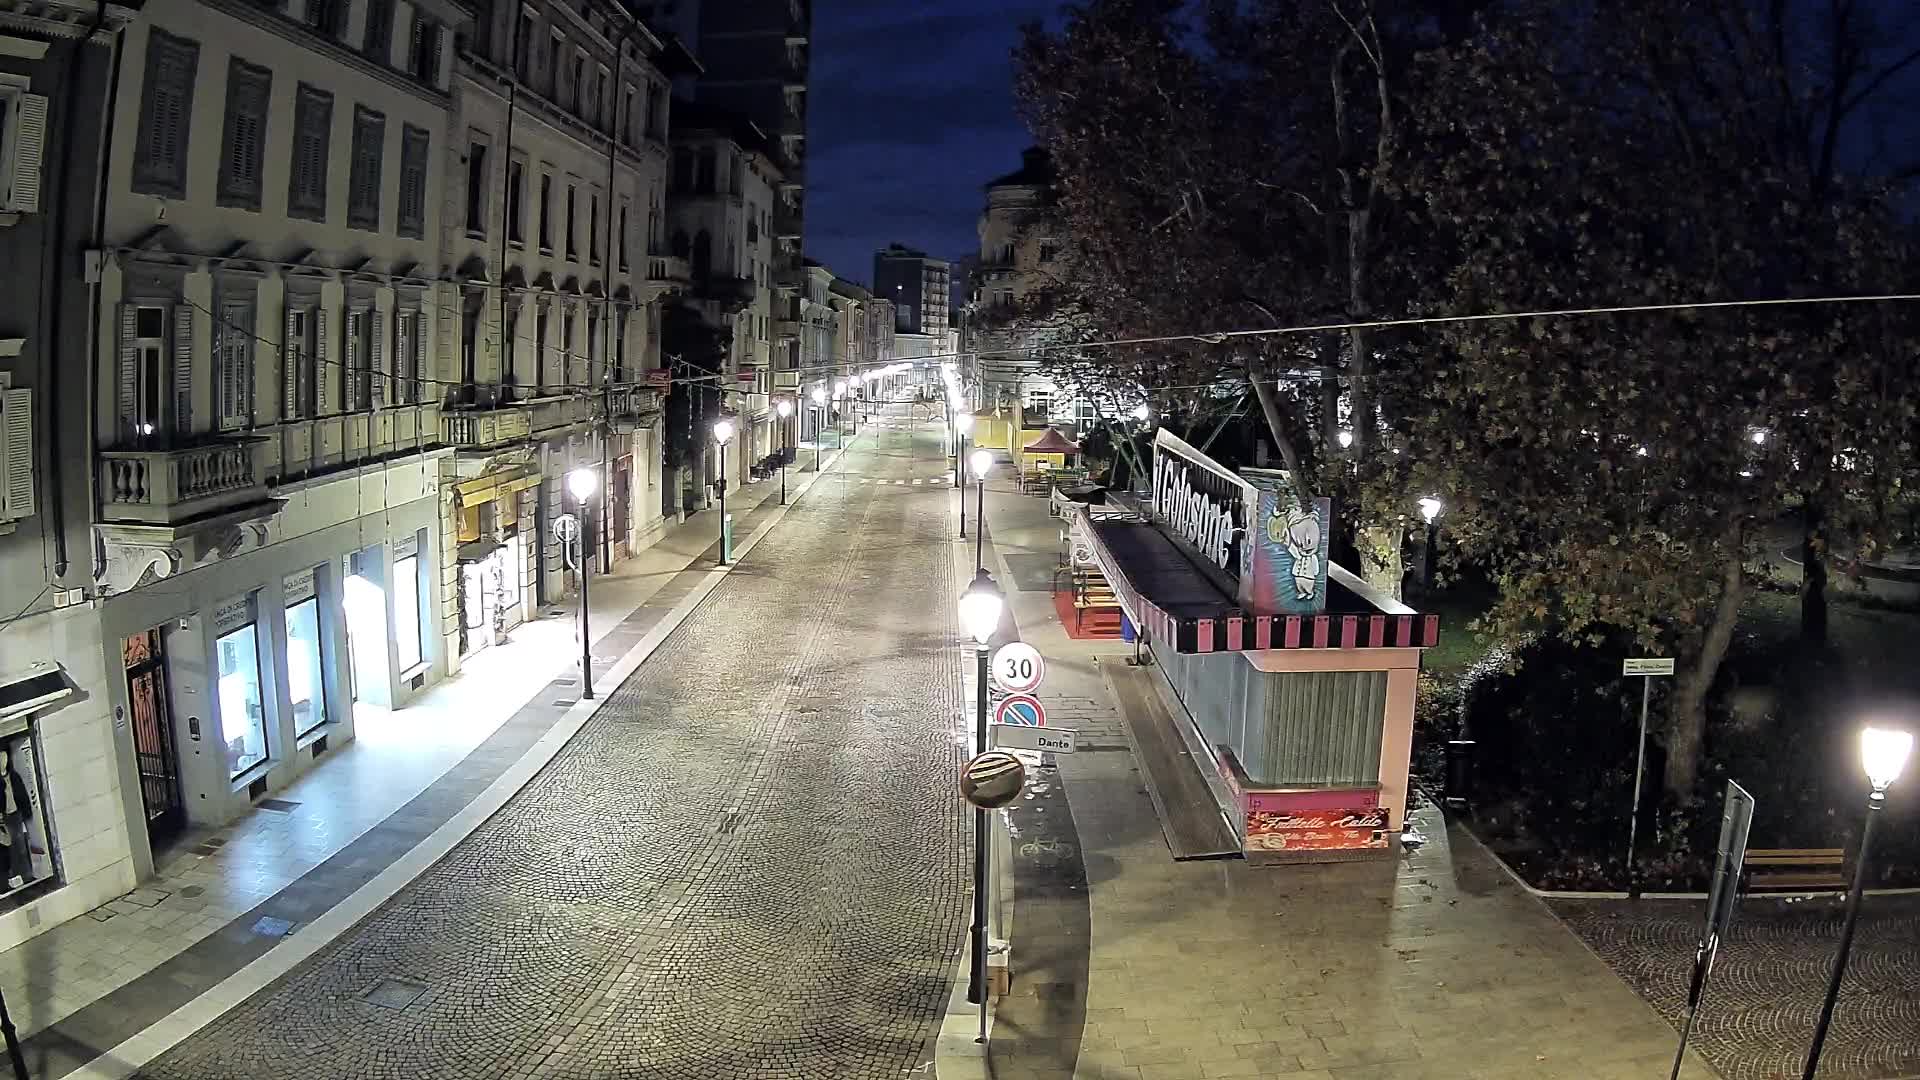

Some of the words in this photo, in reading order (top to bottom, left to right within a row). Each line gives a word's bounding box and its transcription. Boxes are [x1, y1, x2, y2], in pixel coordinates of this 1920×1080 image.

[1163, 458, 1233, 570] Golosone
[1006, 658, 1032, 679] 30
[1038, 737, 1070, 749] Dante
